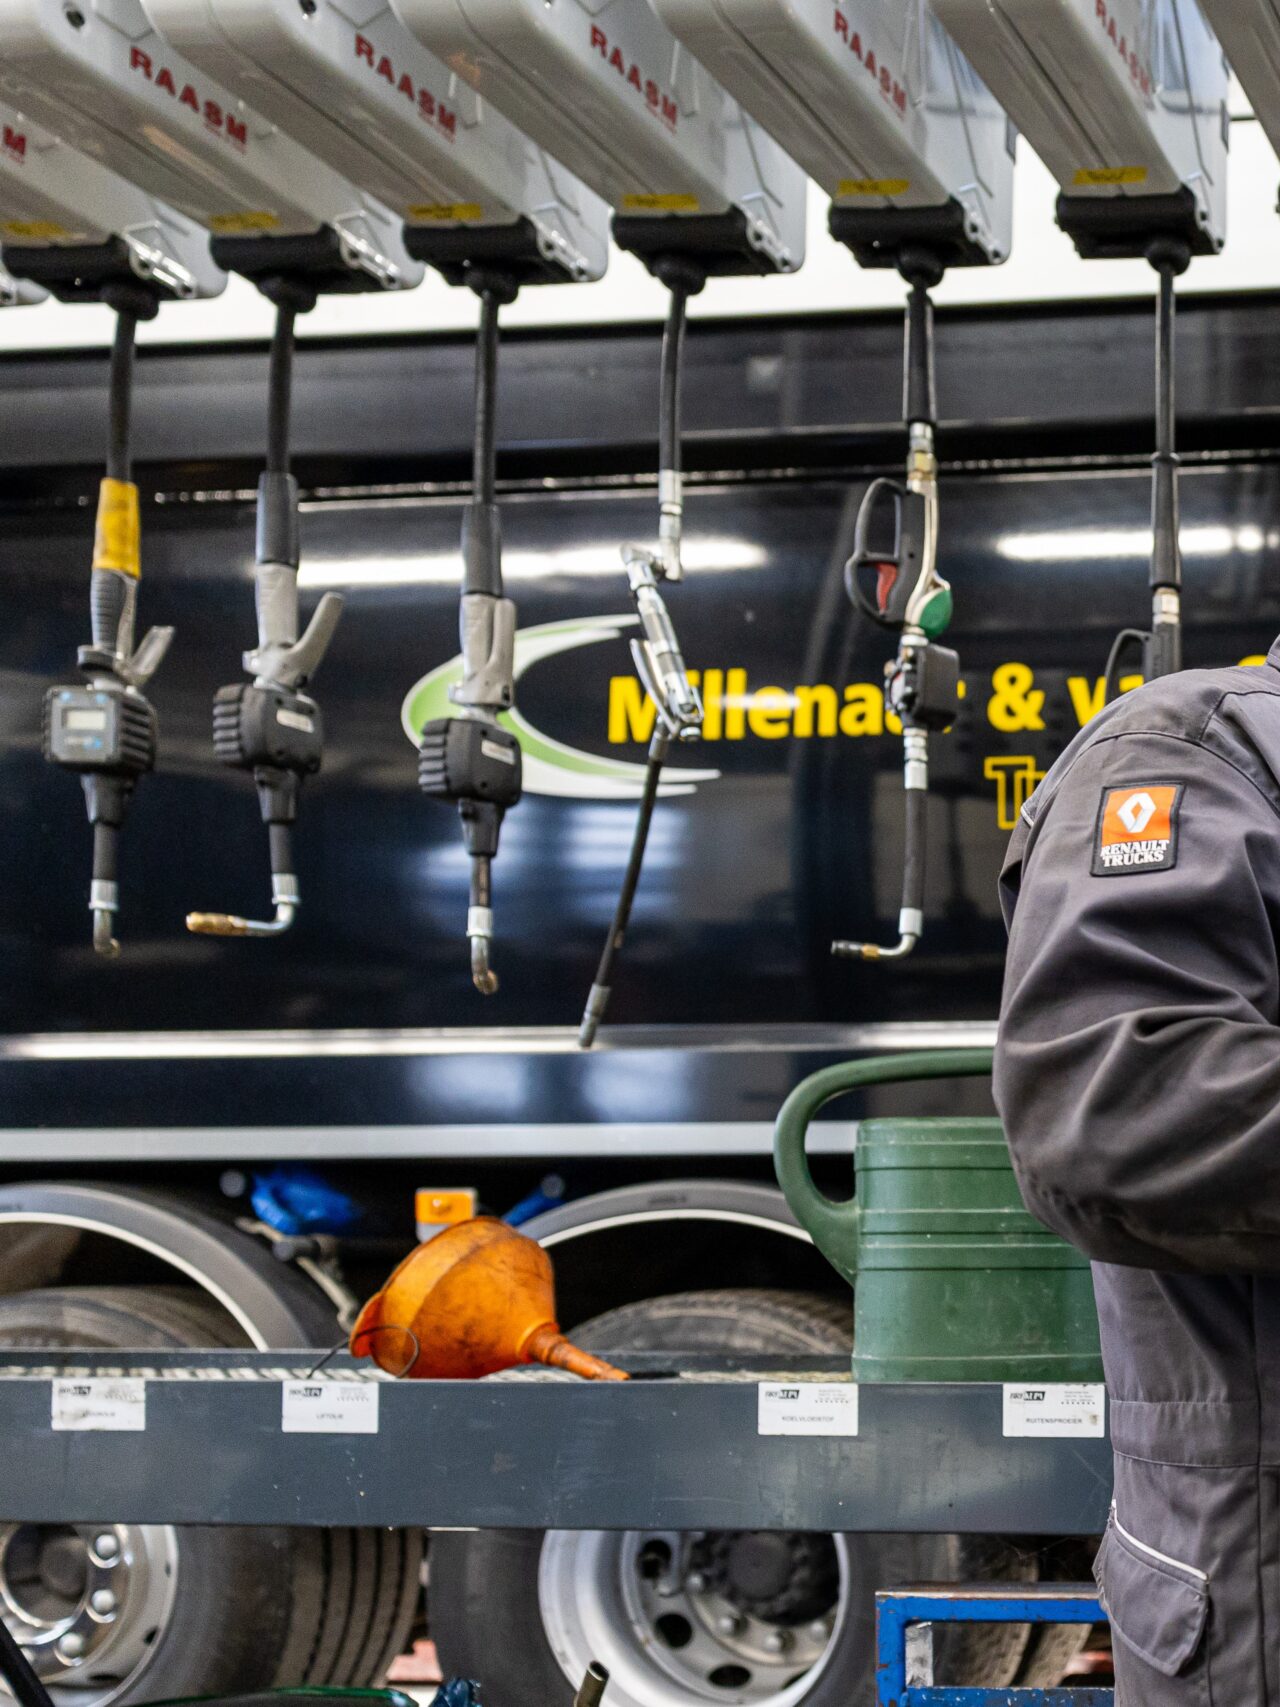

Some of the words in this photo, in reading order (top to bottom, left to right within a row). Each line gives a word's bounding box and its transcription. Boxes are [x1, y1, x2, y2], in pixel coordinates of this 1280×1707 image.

[130, 46, 247, 145] RAASM
[355, 33, 457, 135] RAASM
[590, 23, 678, 126] RAASM
[834, 9, 907, 113] RAASM
[986, 661, 1047, 733] &
[1100, 839, 1171, 857] RENAULT
[1102, 850, 1165, 868] TRUCKS
